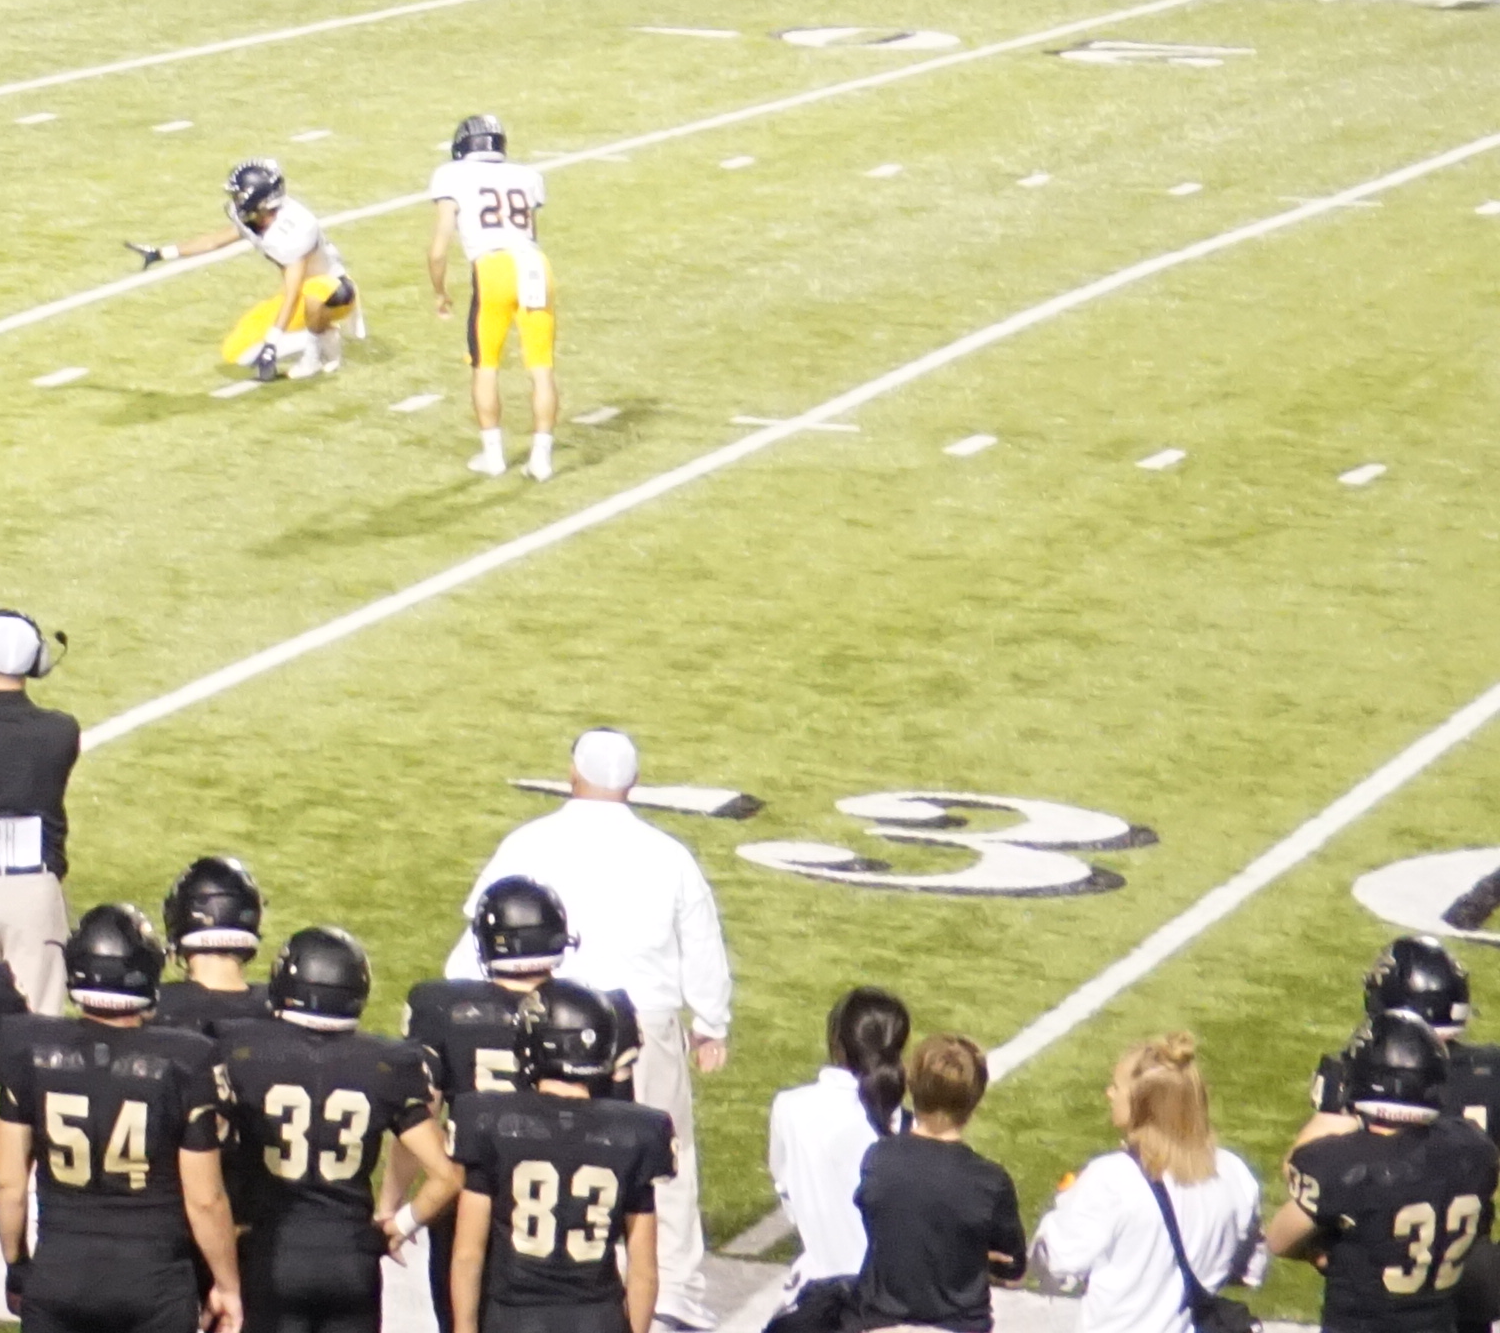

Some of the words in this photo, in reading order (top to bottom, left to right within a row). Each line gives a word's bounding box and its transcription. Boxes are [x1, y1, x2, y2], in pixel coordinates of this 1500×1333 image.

[479, 186, 530, 231] 28
[45, 1091, 149, 1190] 54
[263, 1084, 371, 1182] 33
[512, 1160, 619, 1262] 83
[1288, 1164, 1321, 1214] 32
[1382, 1193, 1482, 1294] 32
